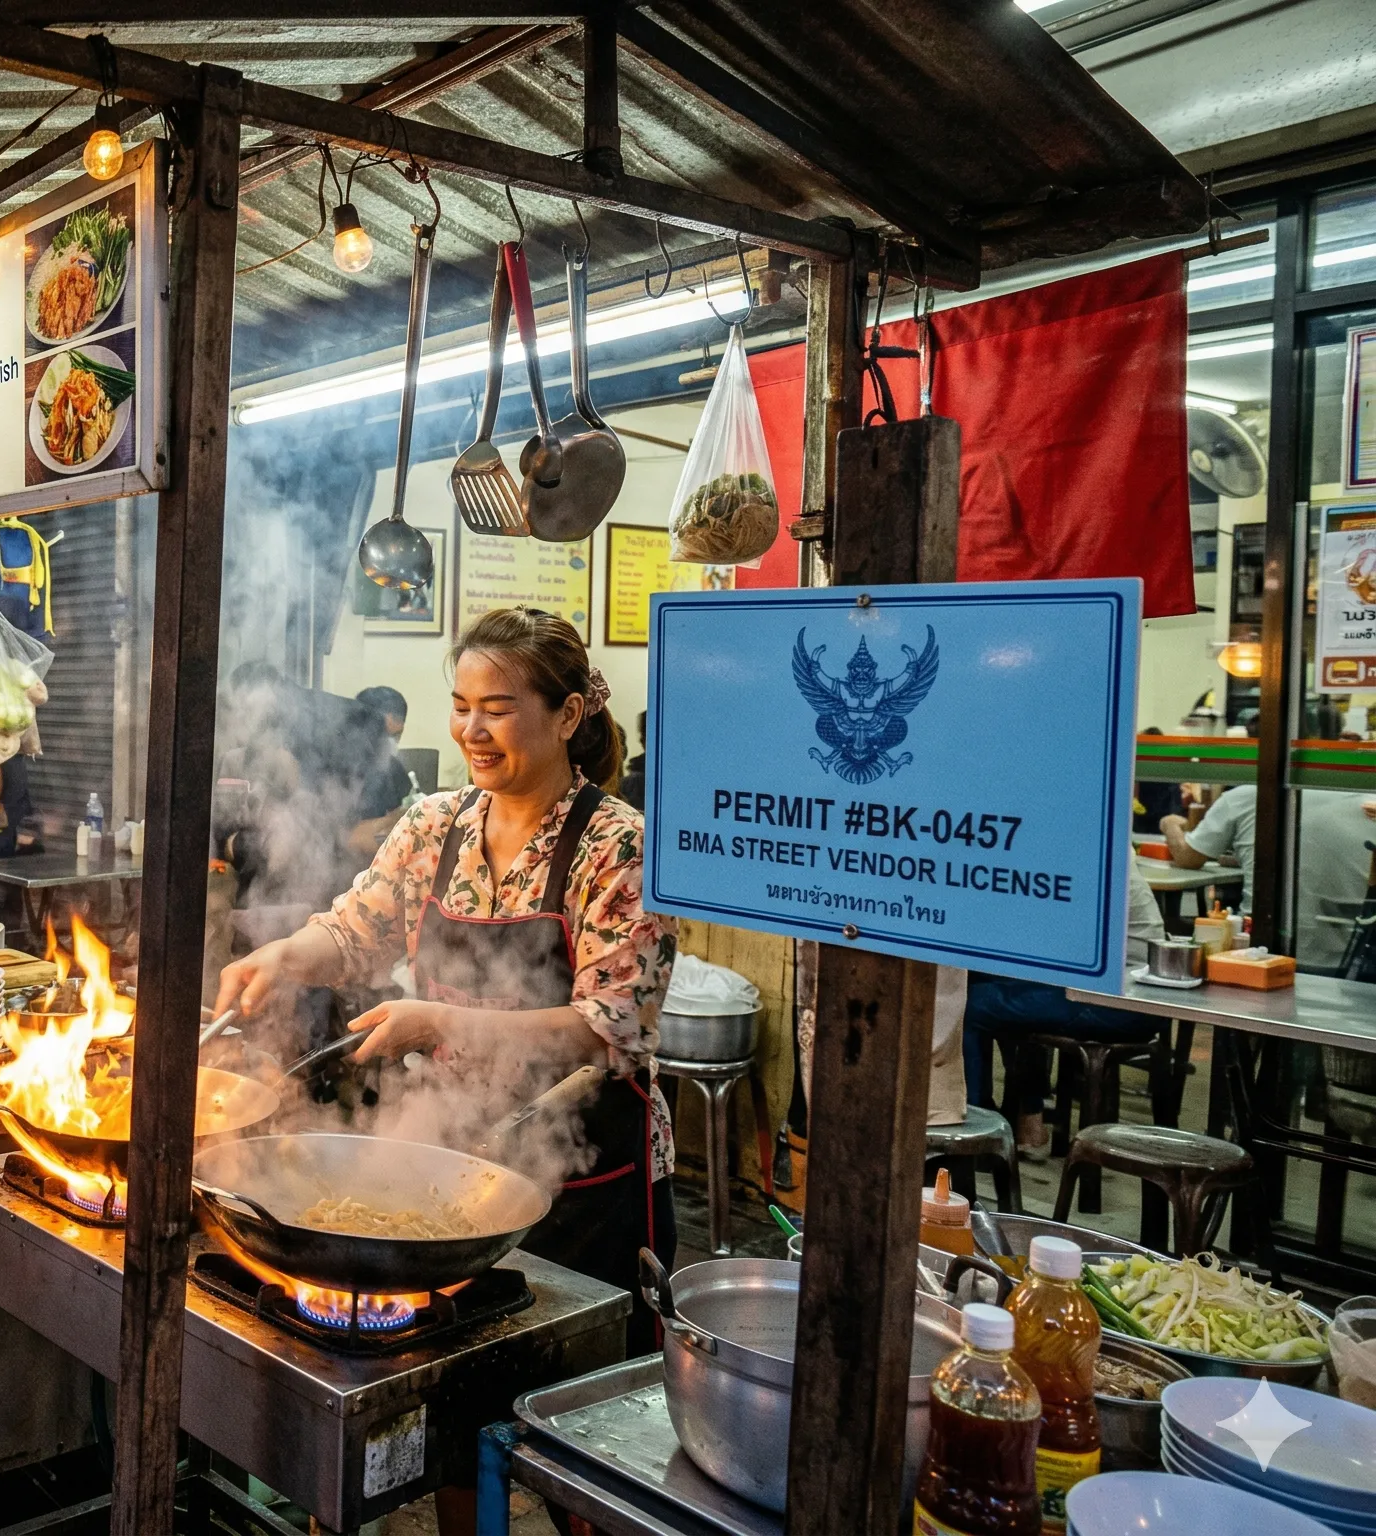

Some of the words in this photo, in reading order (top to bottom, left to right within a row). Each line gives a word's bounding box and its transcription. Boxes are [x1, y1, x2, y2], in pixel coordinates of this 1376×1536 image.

[713, 789, 835, 832] PERMIT
[844, 801, 1023, 851] #BK-0457
[678, 829, 725, 856] BMA
[731, 836, 820, 869] STREET
[827, 847, 937, 885] VENDOR
[945, 861, 1073, 903] LICENSE
